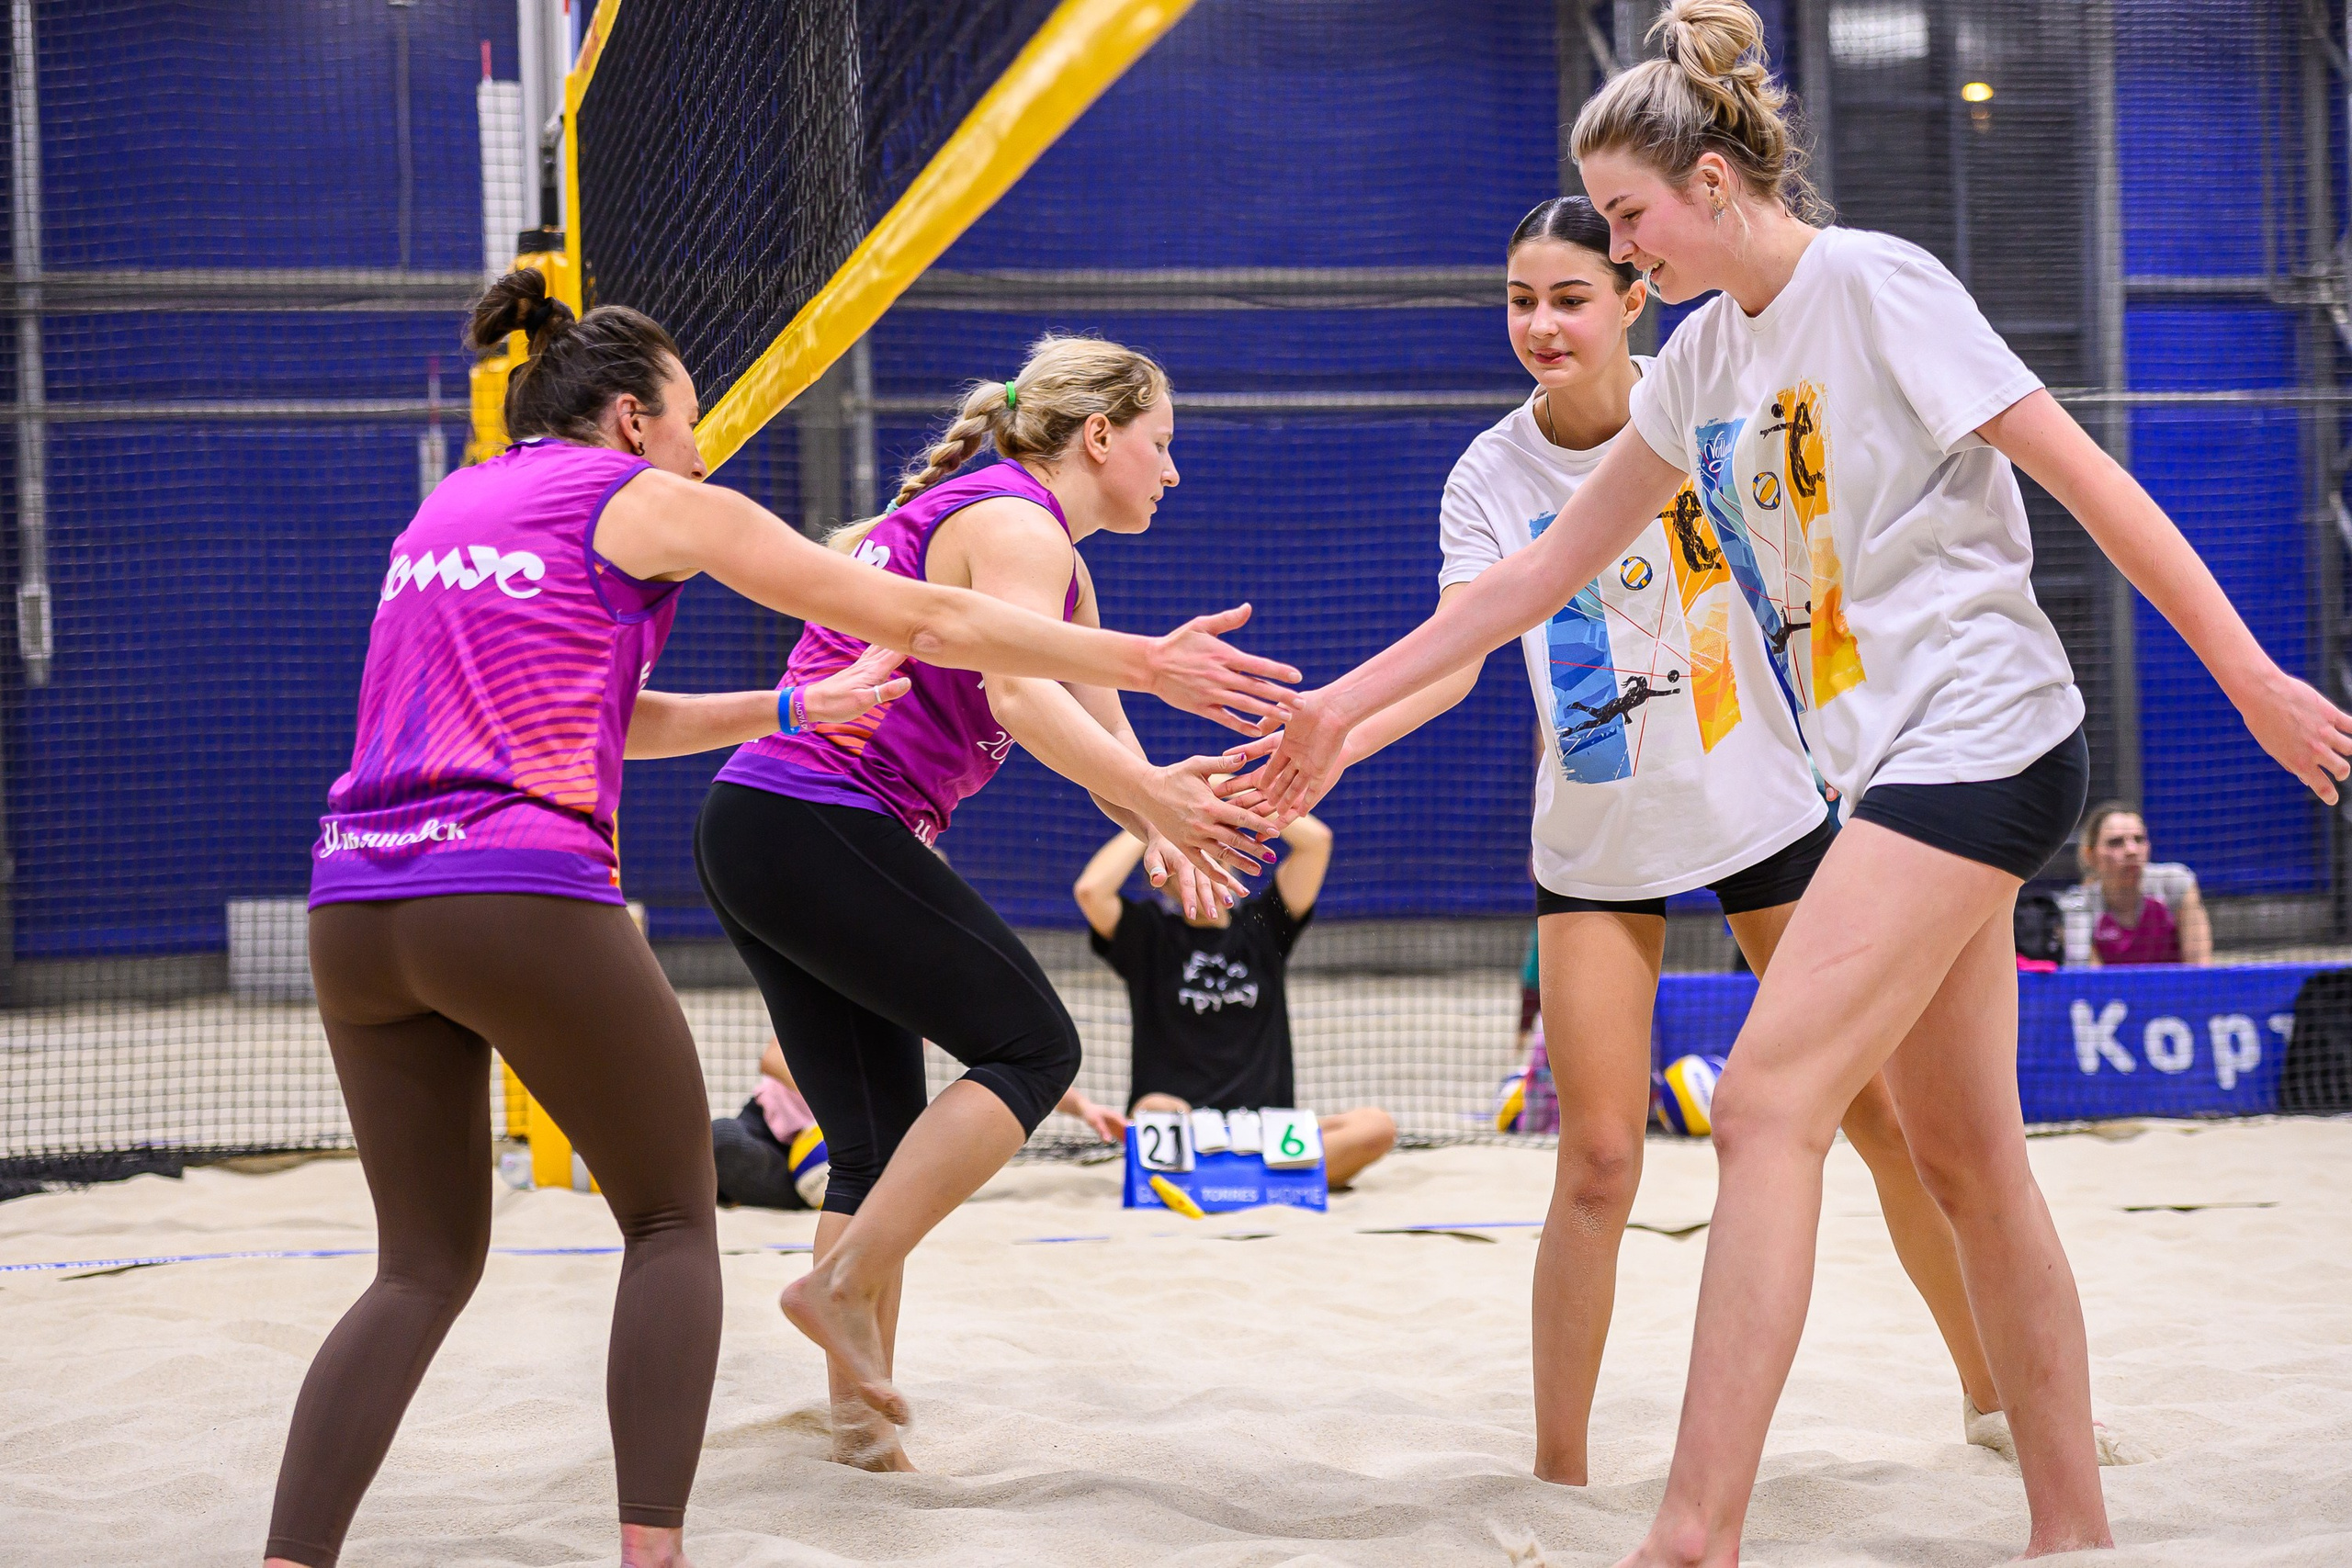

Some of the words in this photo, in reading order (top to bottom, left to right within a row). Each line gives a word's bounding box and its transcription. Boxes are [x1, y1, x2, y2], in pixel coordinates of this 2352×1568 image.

[319, 818, 468, 859] Ульяновск
[1143, 1124, 1184, 1167] 21
[1280, 1123, 1306, 1157] 6
